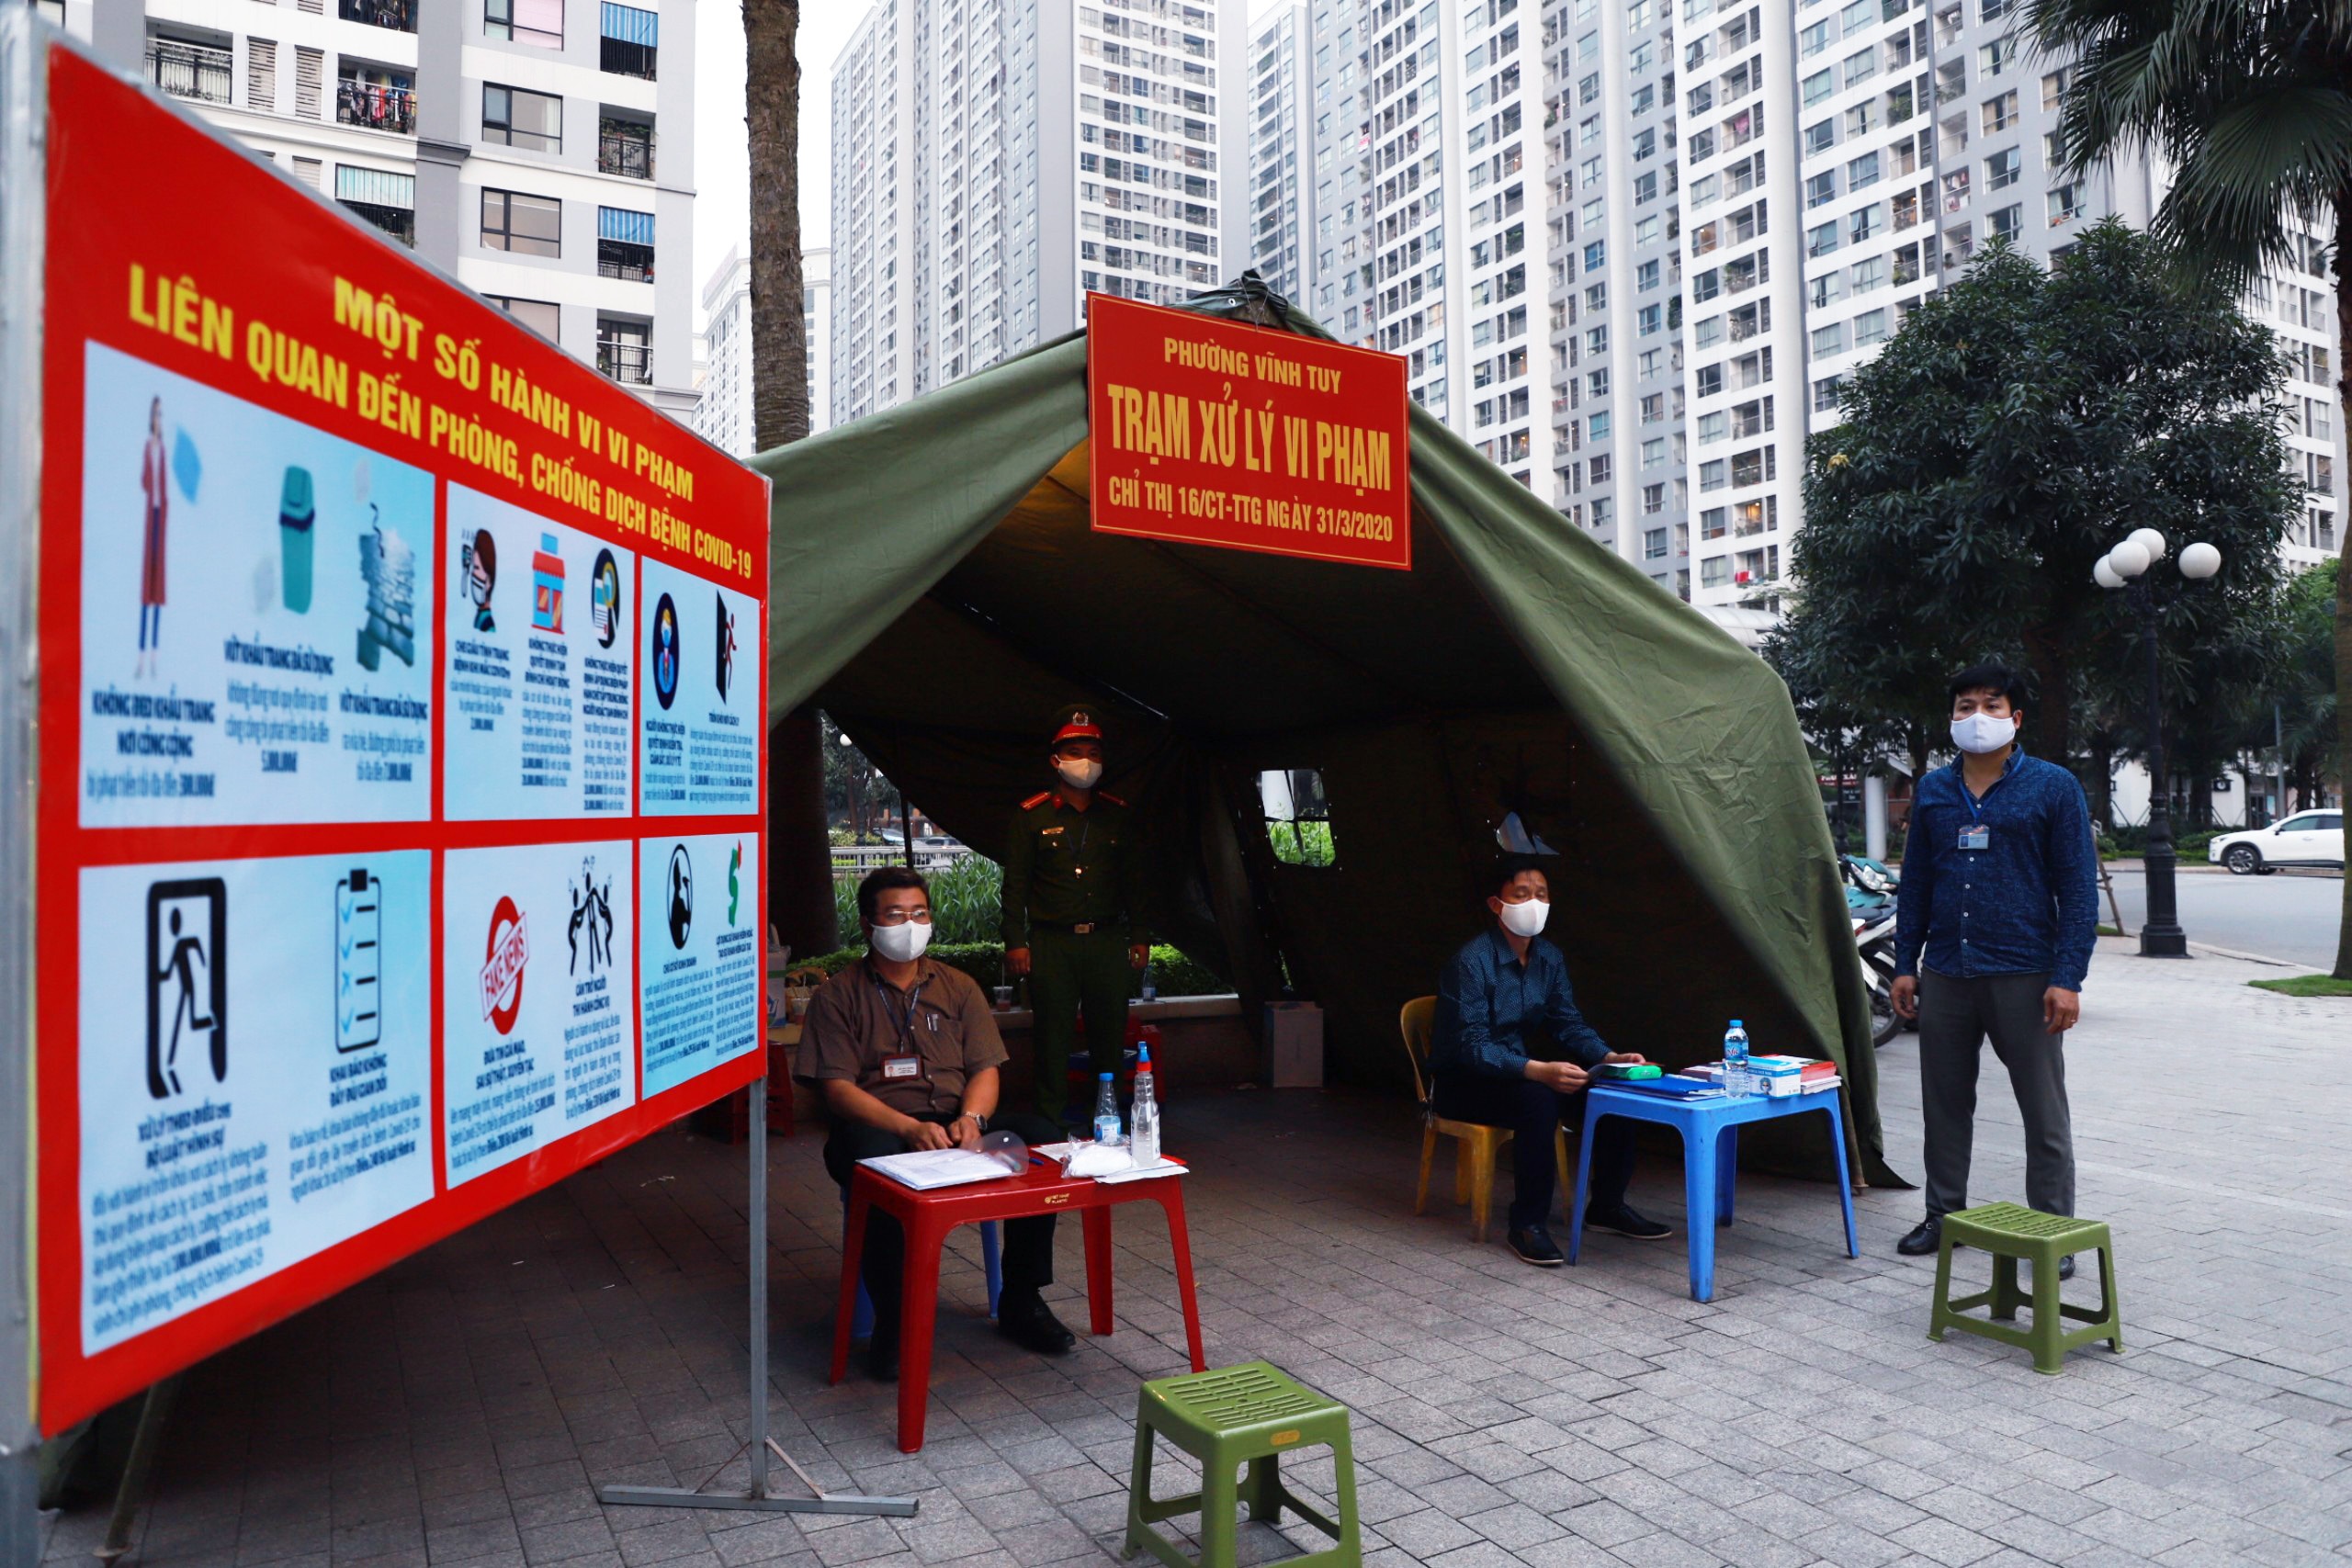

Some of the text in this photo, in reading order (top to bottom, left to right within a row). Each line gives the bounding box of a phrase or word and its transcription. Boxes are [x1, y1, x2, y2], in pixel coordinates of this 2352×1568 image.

[129, 263, 752, 579] LIÊN QUAN ĐẾN PHÒNG, CHỐNG DỊCH BỆNH COVID-19
[333, 275, 694, 502] MỘT SỐ HÀNH VI VI PHẠM
[1164, 336, 1341, 394] PHƯỜNG VĨNH TUY
[1107, 381, 1391, 497] TRẠM XỬ LÝ VI PHẠM
[1109, 468, 1393, 542] CHỈ THỊ 16/CT-TTG NGÀY 31/3/2020
